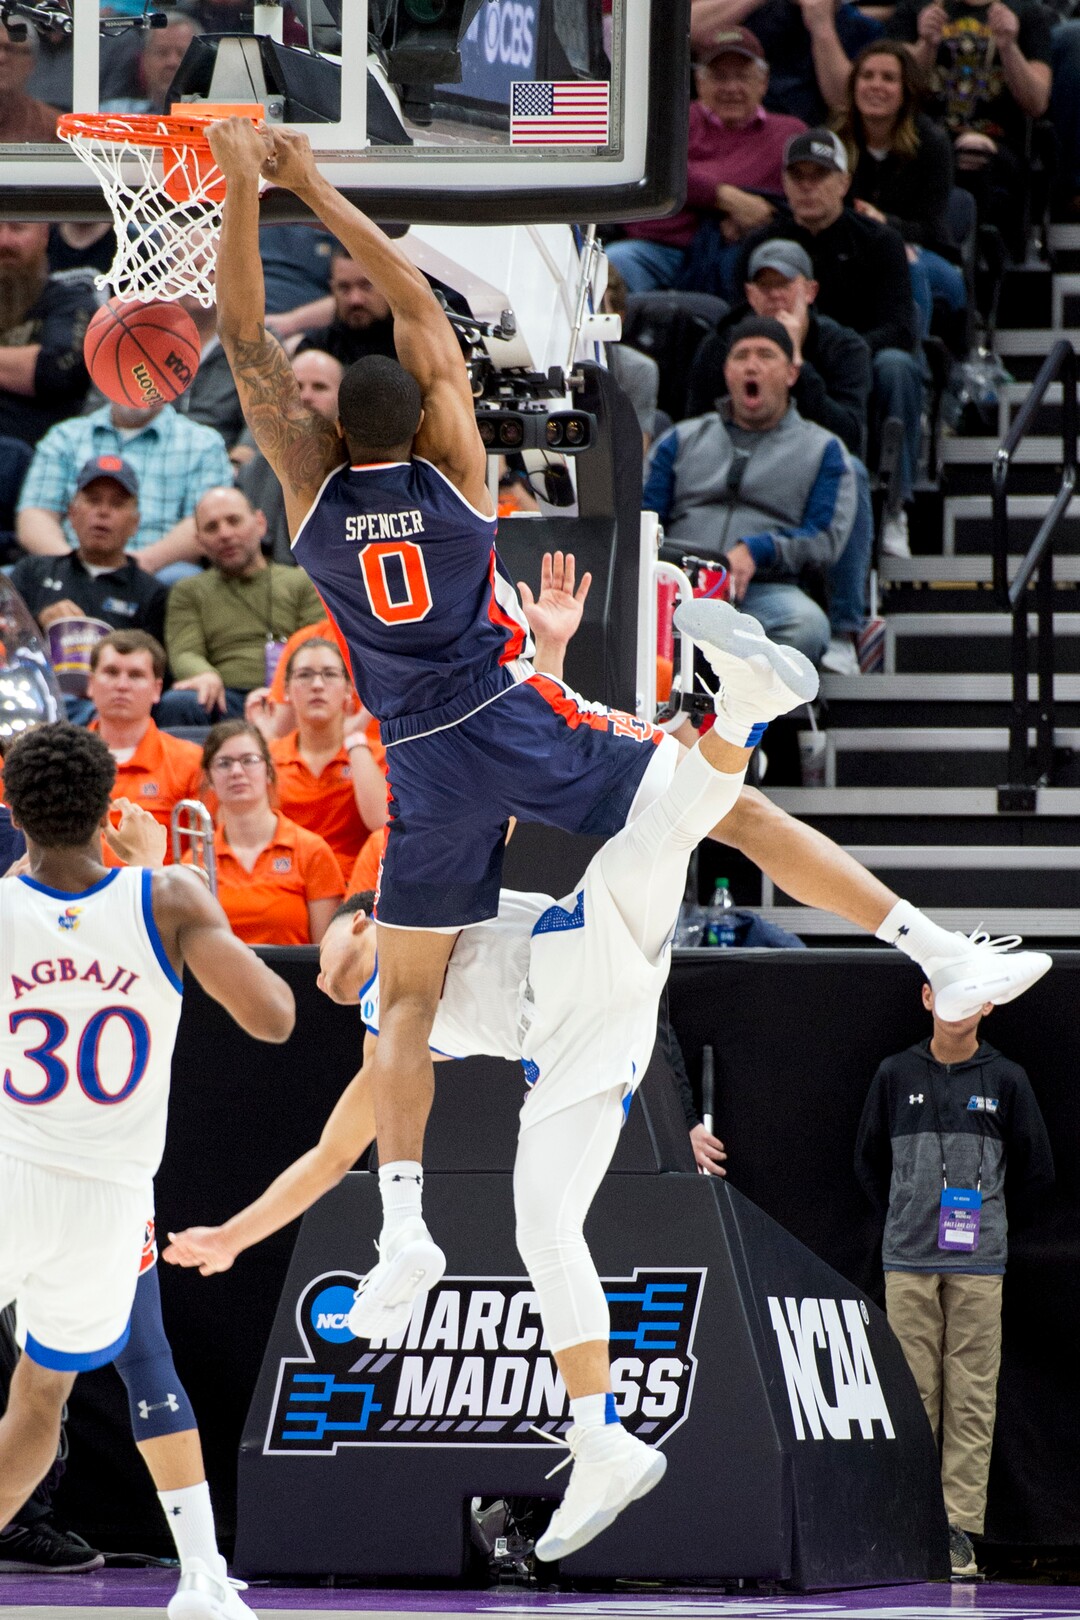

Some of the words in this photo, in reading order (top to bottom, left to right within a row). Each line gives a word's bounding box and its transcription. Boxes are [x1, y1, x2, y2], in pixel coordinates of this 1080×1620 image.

[500, 1, 535, 69] CBS
[345, 510, 425, 541] SPENCER
[358, 541, 434, 627] 0
[10, 957, 140, 1000] AGBAJI
[3, 1004, 152, 1106] 30
[316, 1313, 352, 1329] NCA
[369, 1290, 554, 1350] MARC
[393, 1356, 685, 1418] MADNSS
